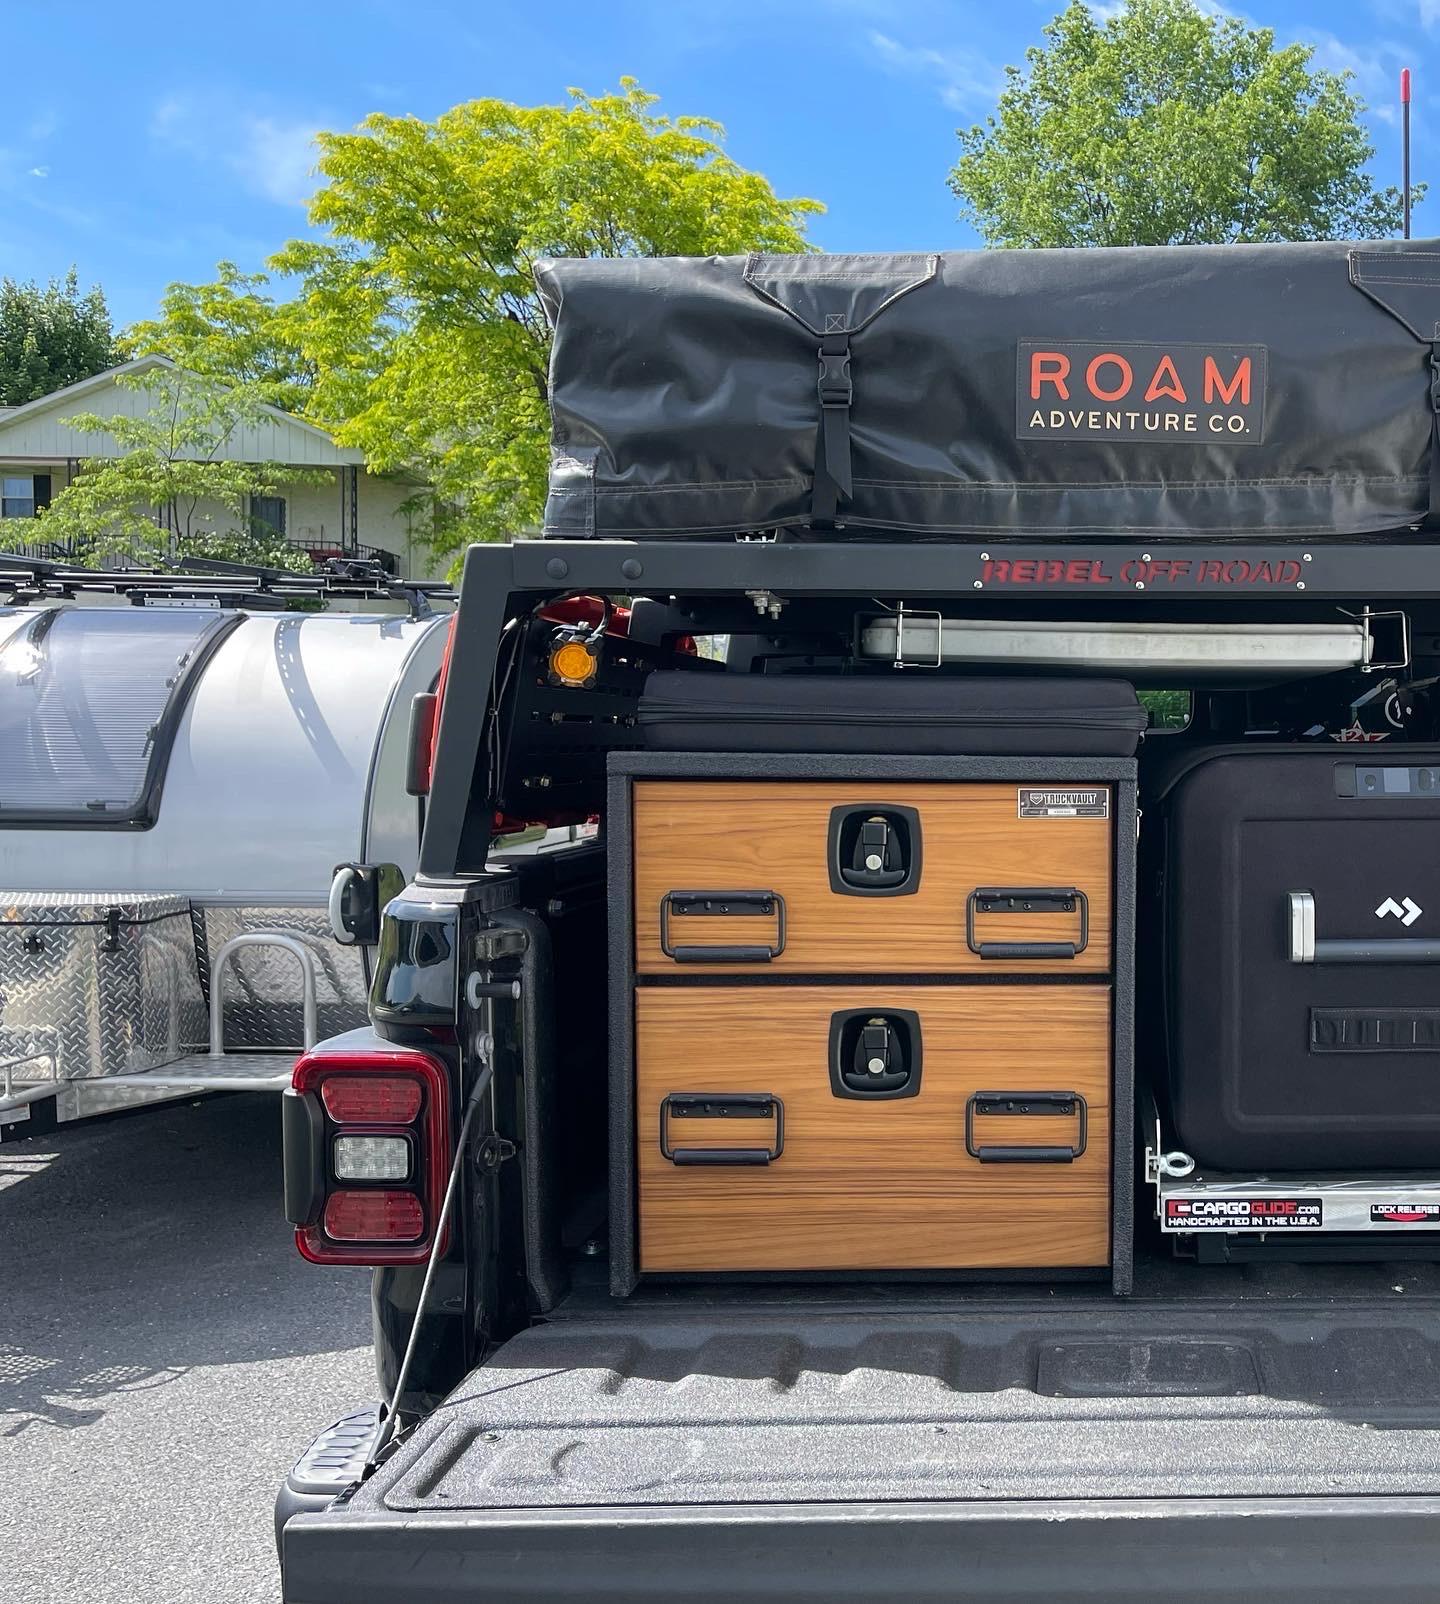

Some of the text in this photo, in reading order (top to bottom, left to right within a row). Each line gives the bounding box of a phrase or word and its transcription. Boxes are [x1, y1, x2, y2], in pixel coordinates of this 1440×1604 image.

[1030, 352, 1251, 405] ROAM
[1029, 409, 1250, 433] ADVENTURE CO.
[982, 559, 1300, 584] REBEL OFF ROAD
[1043, 792, 1096, 804] TRUCKVAULT
[1372, 1205, 1440, 1214] LOCK RELEASE
[1168, 1216, 1320, 1226] HANDCRAFTED IN THE U.S.A.
